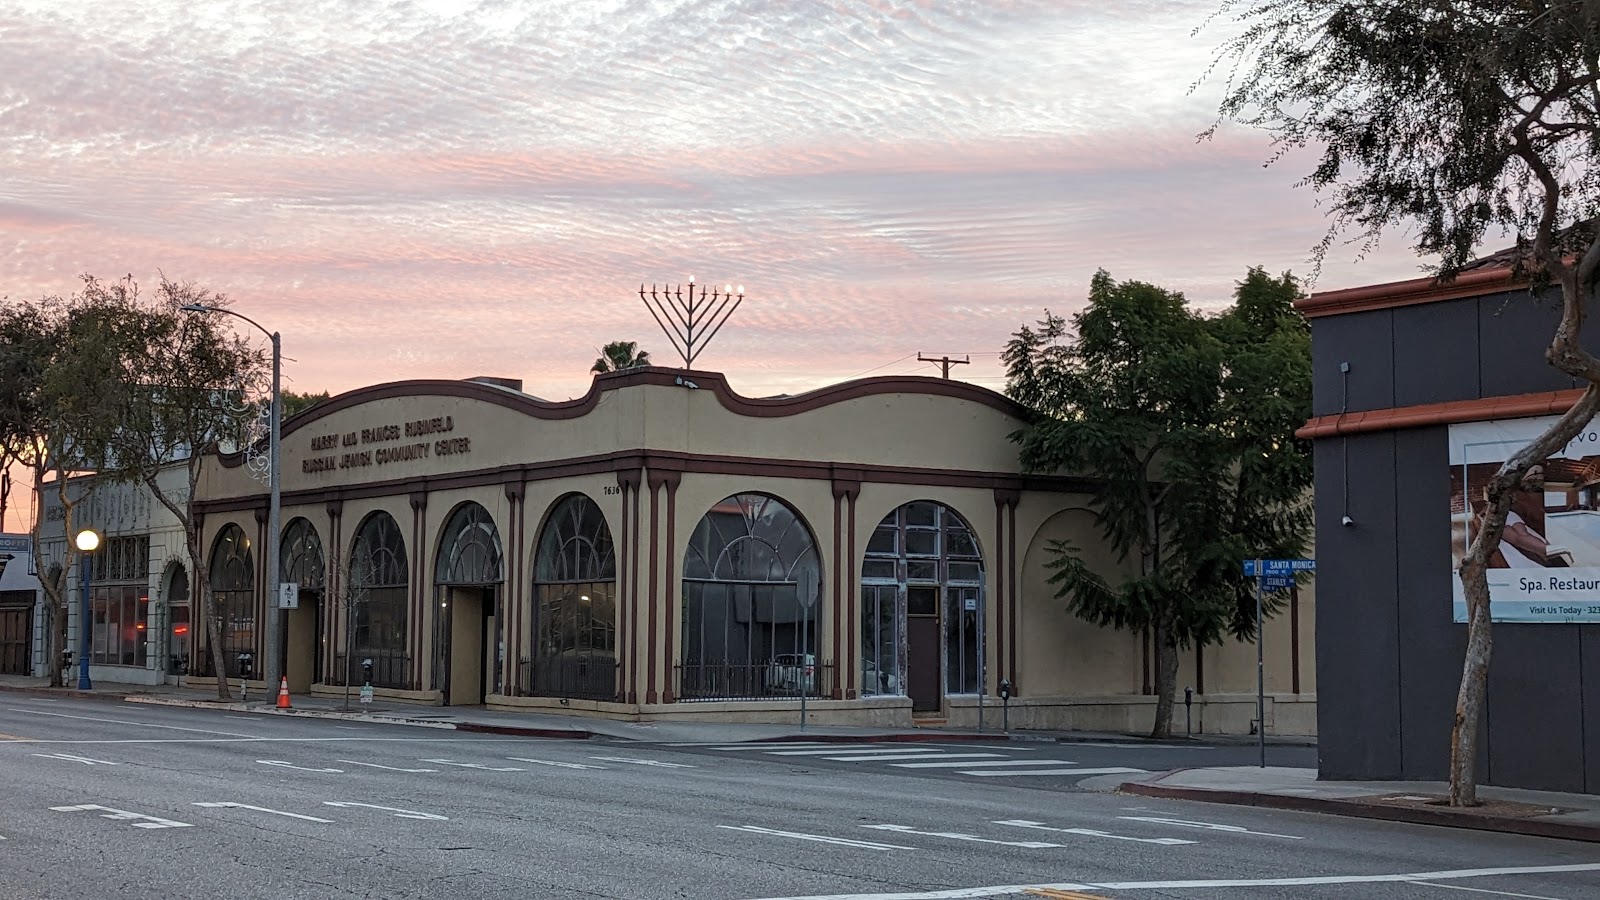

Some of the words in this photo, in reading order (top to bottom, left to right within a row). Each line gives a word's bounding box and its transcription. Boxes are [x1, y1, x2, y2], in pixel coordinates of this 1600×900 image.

[311, 434, 339, 451] HARRY
[342, 432, 358, 447] AND
[362, 425, 400, 444] FRANCES
[405, 415, 454, 437] RUBINFELD
[302, 456, 336, 473] RUSSIAN
[339, 451, 373, 469] JEWISH
[375, 443, 430, 465] COMMUNITY
[435, 437, 471, 456] CENTER
[603, 486, 620, 495] 7636
[1269, 561, 1289, 569] SANTA
[1291, 560, 1316, 569] MONICA
[1266, 577, 1287, 586] STANLEY
[1519, 577, 1546, 594] Spa.
[1549, 576, 1600, 591] Restaur
[1529, 606, 1546, 614] Visit
[1547, 606, 1557, 614] Us
[1558, 606, 1582, 616] Today
